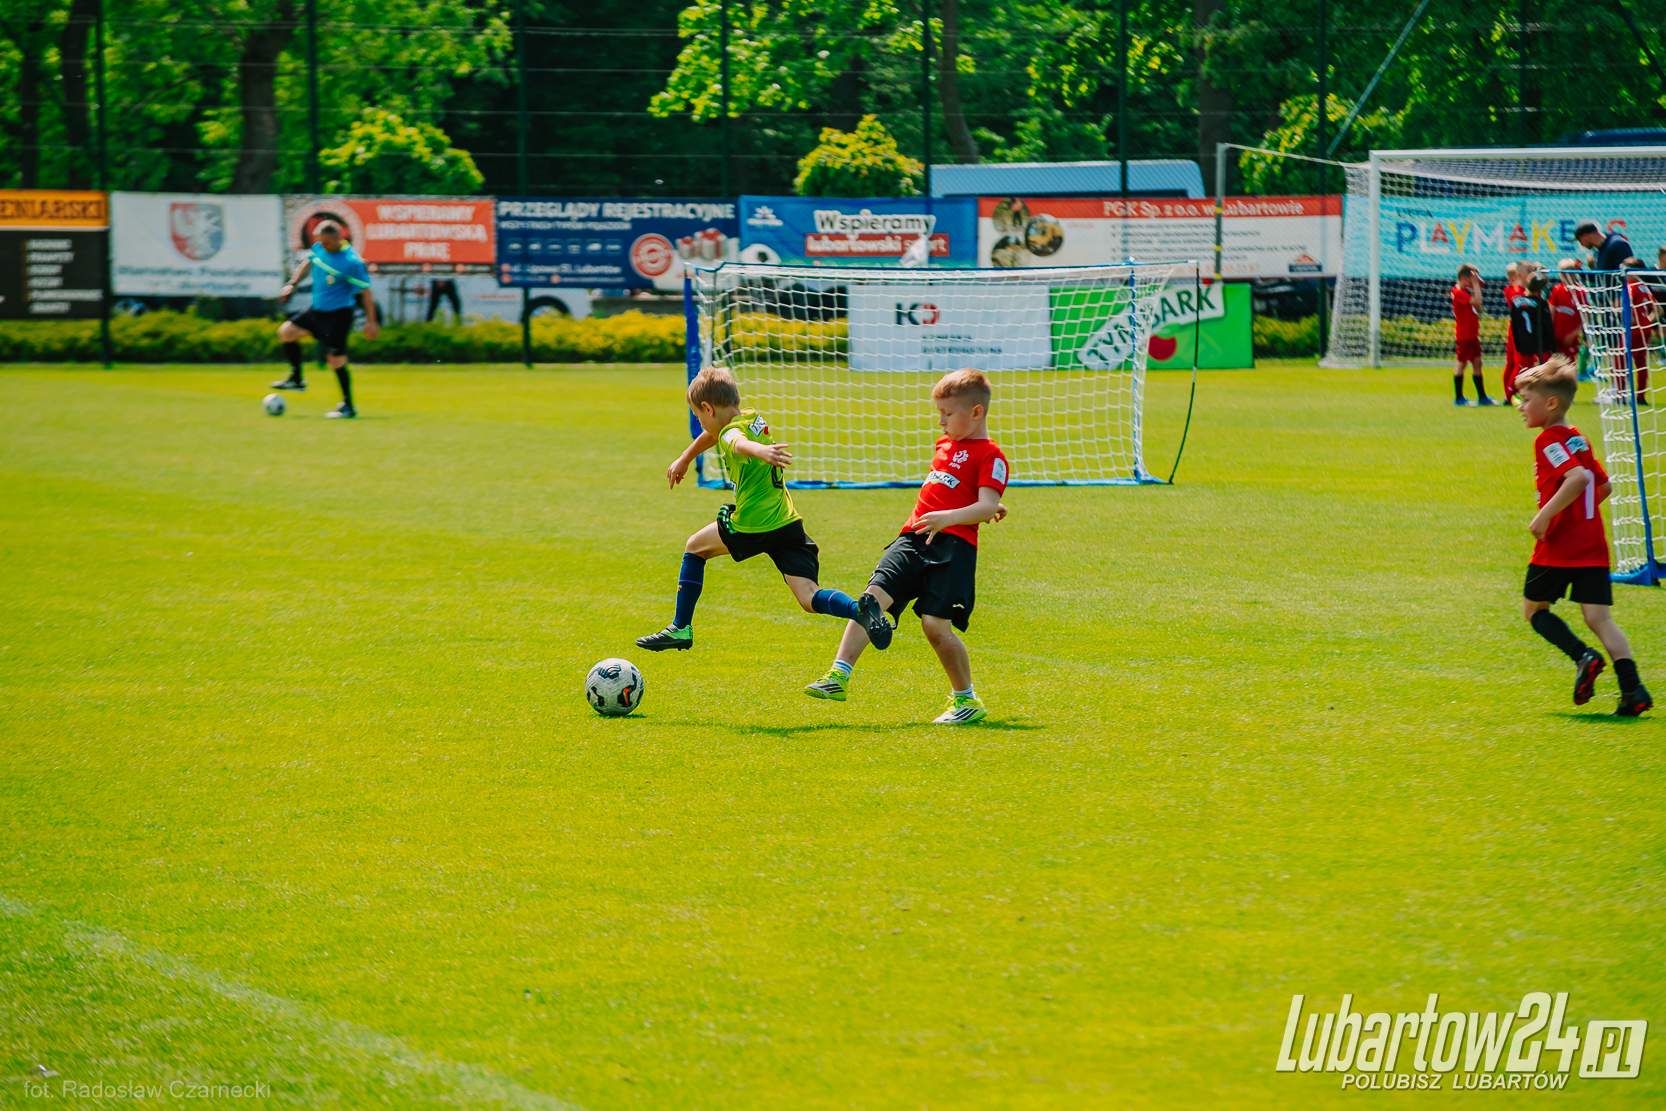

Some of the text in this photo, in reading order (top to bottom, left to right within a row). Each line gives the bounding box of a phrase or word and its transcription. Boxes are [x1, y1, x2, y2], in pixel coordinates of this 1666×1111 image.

[499, 201, 736, 221] PRZEGLĄDY REJESTRACYJNE
[1102, 201, 1138, 216] PGK
[817, 210, 932, 234] Wspieramy
[904, 237, 947, 253] srt
[1396, 219, 1628, 255] PLAYMAKES
